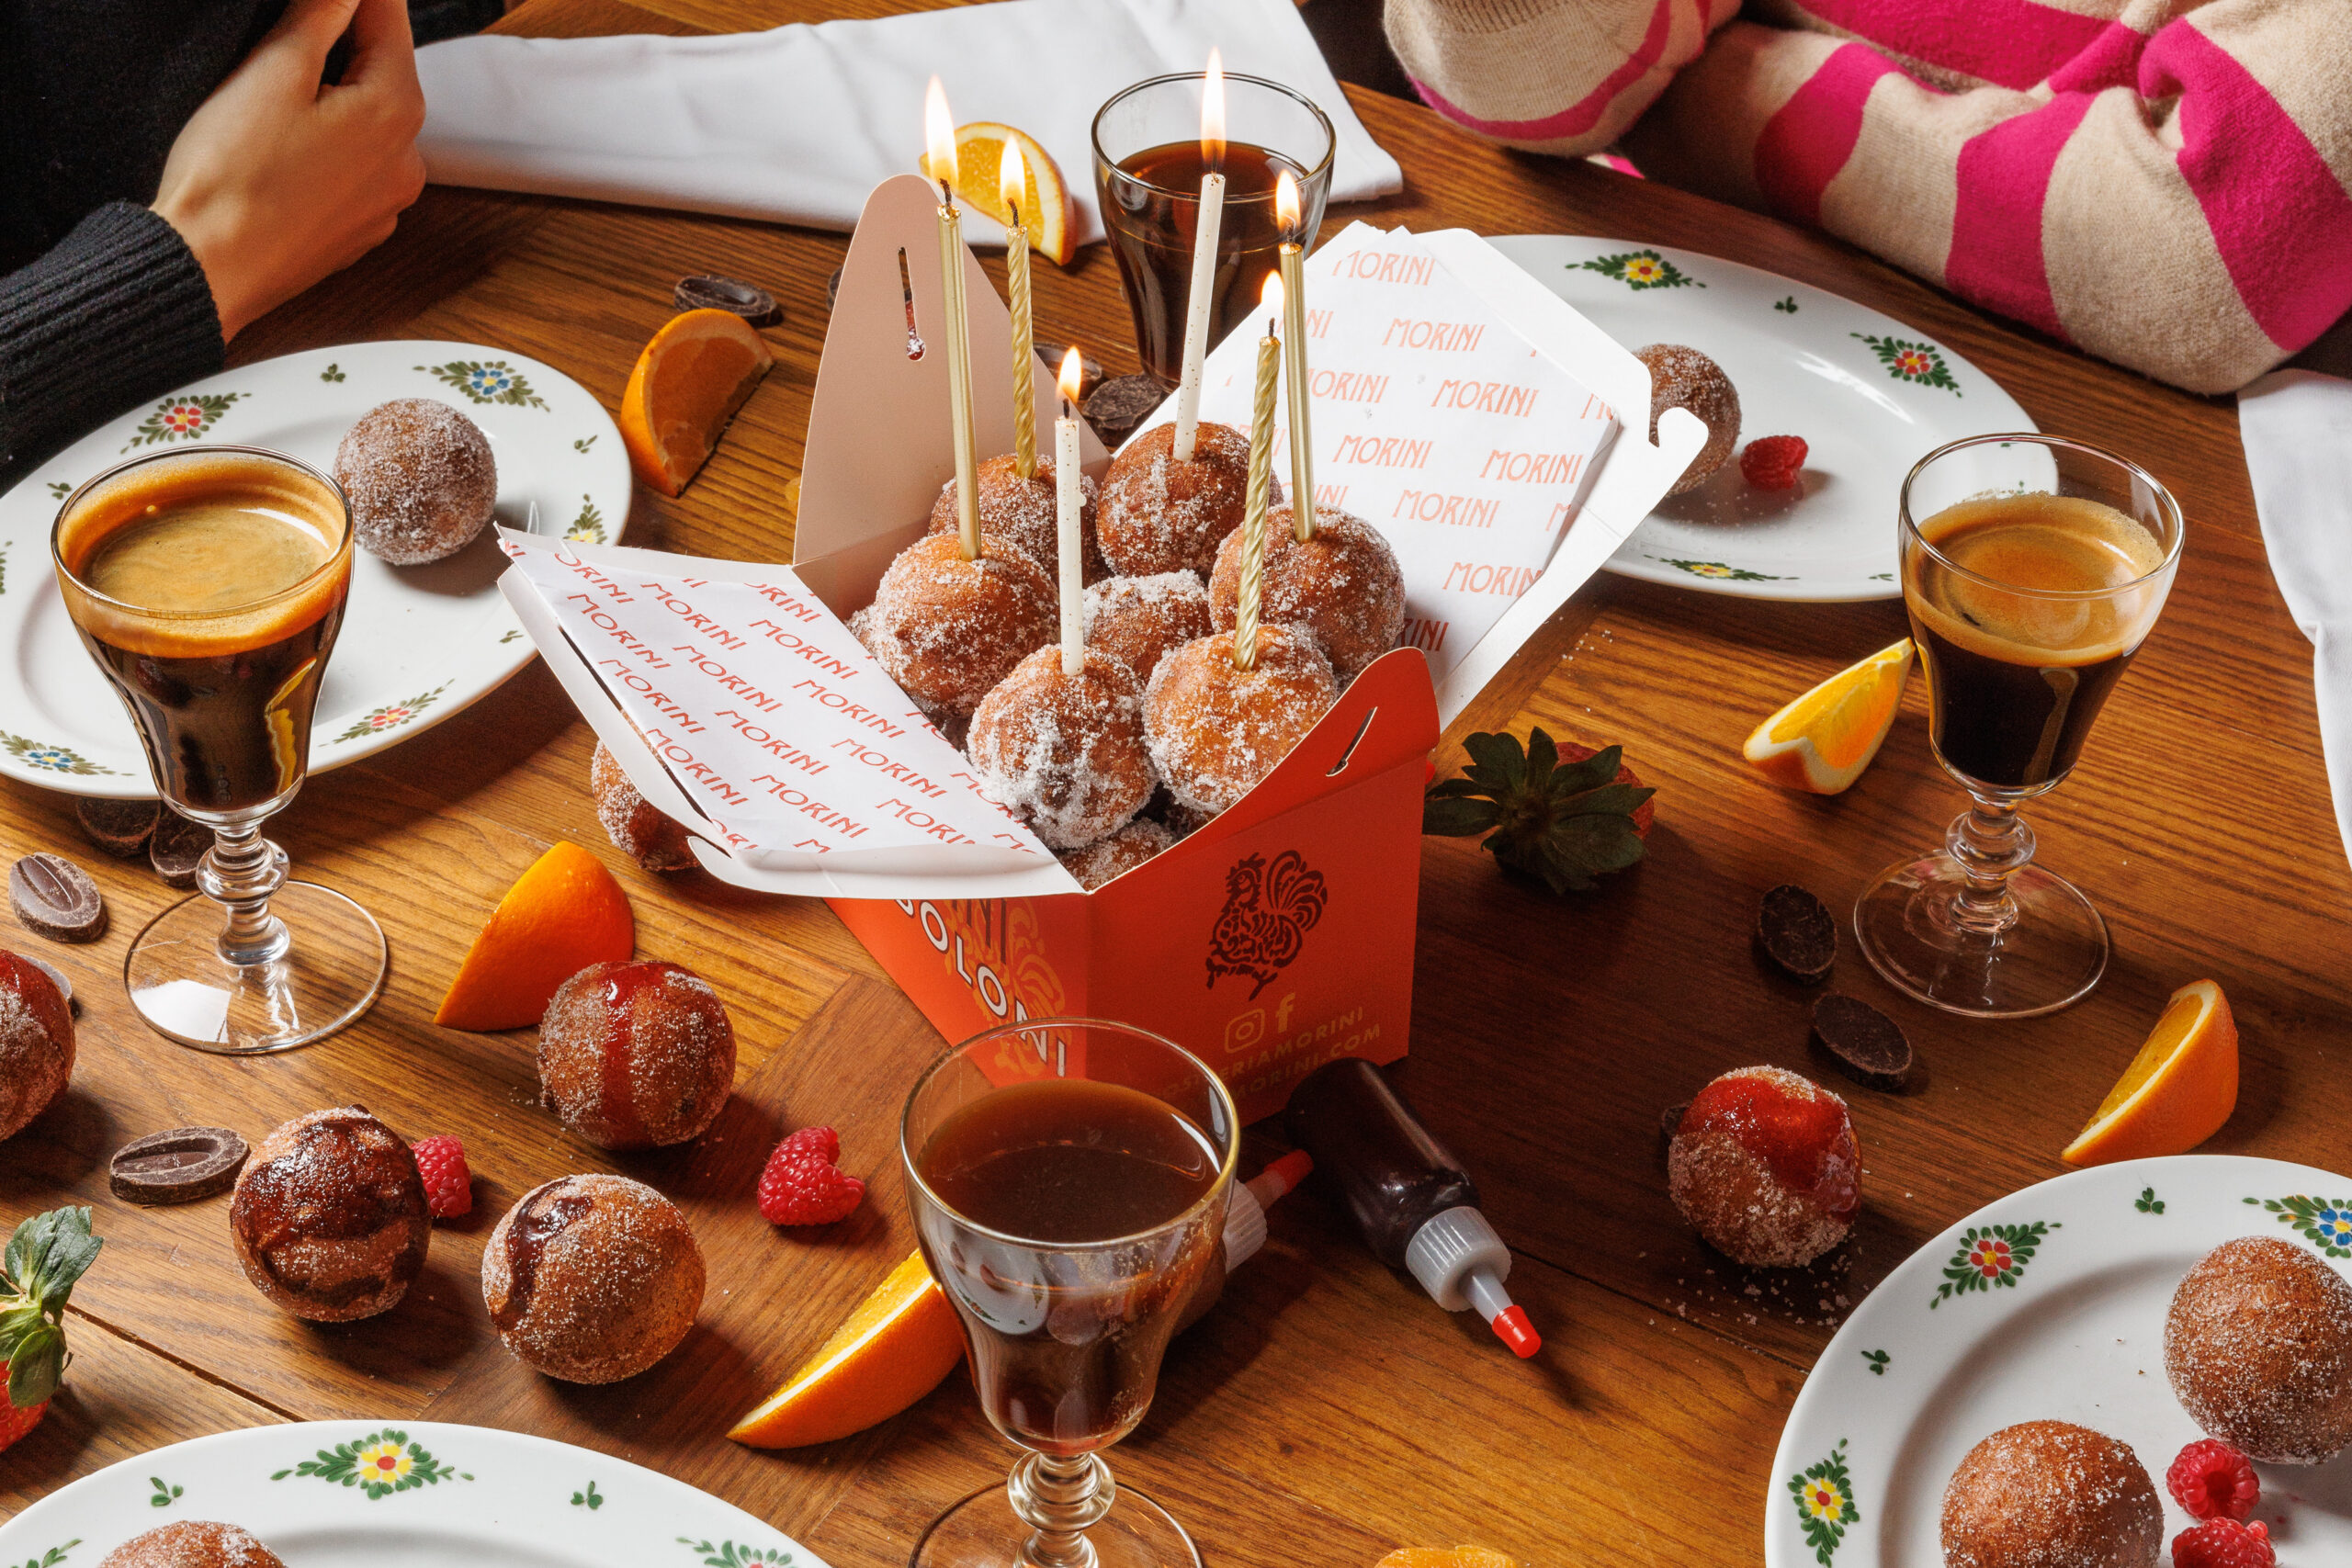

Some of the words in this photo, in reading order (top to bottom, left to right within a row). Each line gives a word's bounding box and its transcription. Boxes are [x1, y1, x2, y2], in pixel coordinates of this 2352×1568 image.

[1332, 250, 1436, 286] MORINI
[1382, 318, 1486, 352] MORINI
[1430, 379, 1540, 418] MORINI
[1332, 434, 1433, 469] MORINI
[1479, 449, 1583, 484] MORINI
[1392, 490, 1500, 528] MORINI
[567, 593, 672, 670] MORINI
[640, 582, 748, 650] MORINI
[672, 645, 783, 713] MORINI
[748, 619, 859, 680] MORINI
[599, 659, 707, 734] MORINI
[793, 679, 906, 739] MORINI
[645, 728, 750, 806] MORINI
[714, 709, 830, 776] MORINI
[831, 738, 947, 798] MORINI
[750, 774, 871, 839] MORINI
[876, 798, 976, 844] MORI
